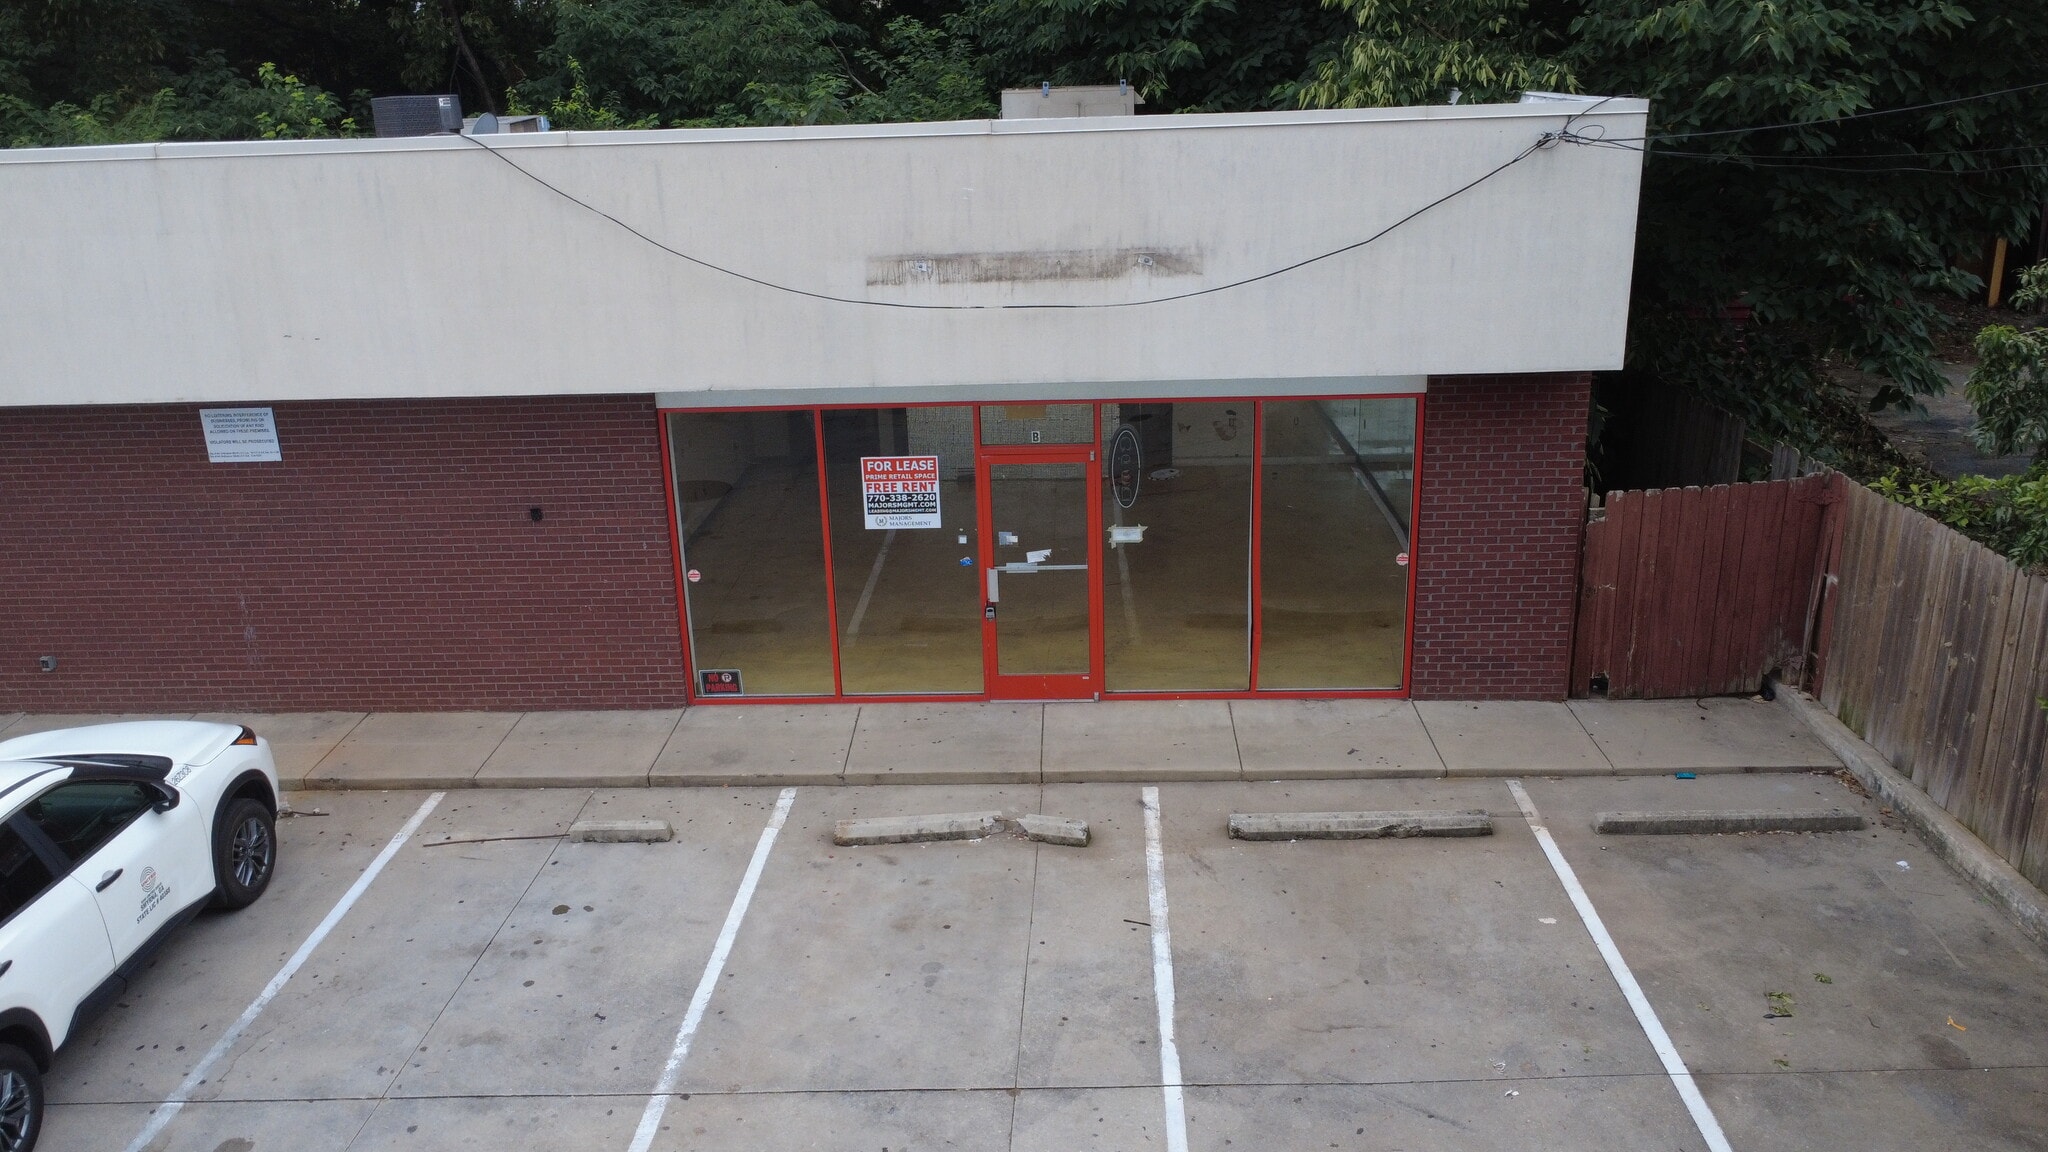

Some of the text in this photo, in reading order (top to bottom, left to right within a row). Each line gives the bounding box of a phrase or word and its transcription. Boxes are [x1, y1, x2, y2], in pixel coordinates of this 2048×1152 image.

[1033, 432, 1039, 441] B
[867, 460, 934, 472] FOR LEASE
[866, 482, 936, 493] FREE RENT
[868, 494, 936, 502] 770-338-2620
[708, 674, 718, 682] NO
[706, 684, 737, 692] PARKING
[137, 908, 149, 924] STATE
